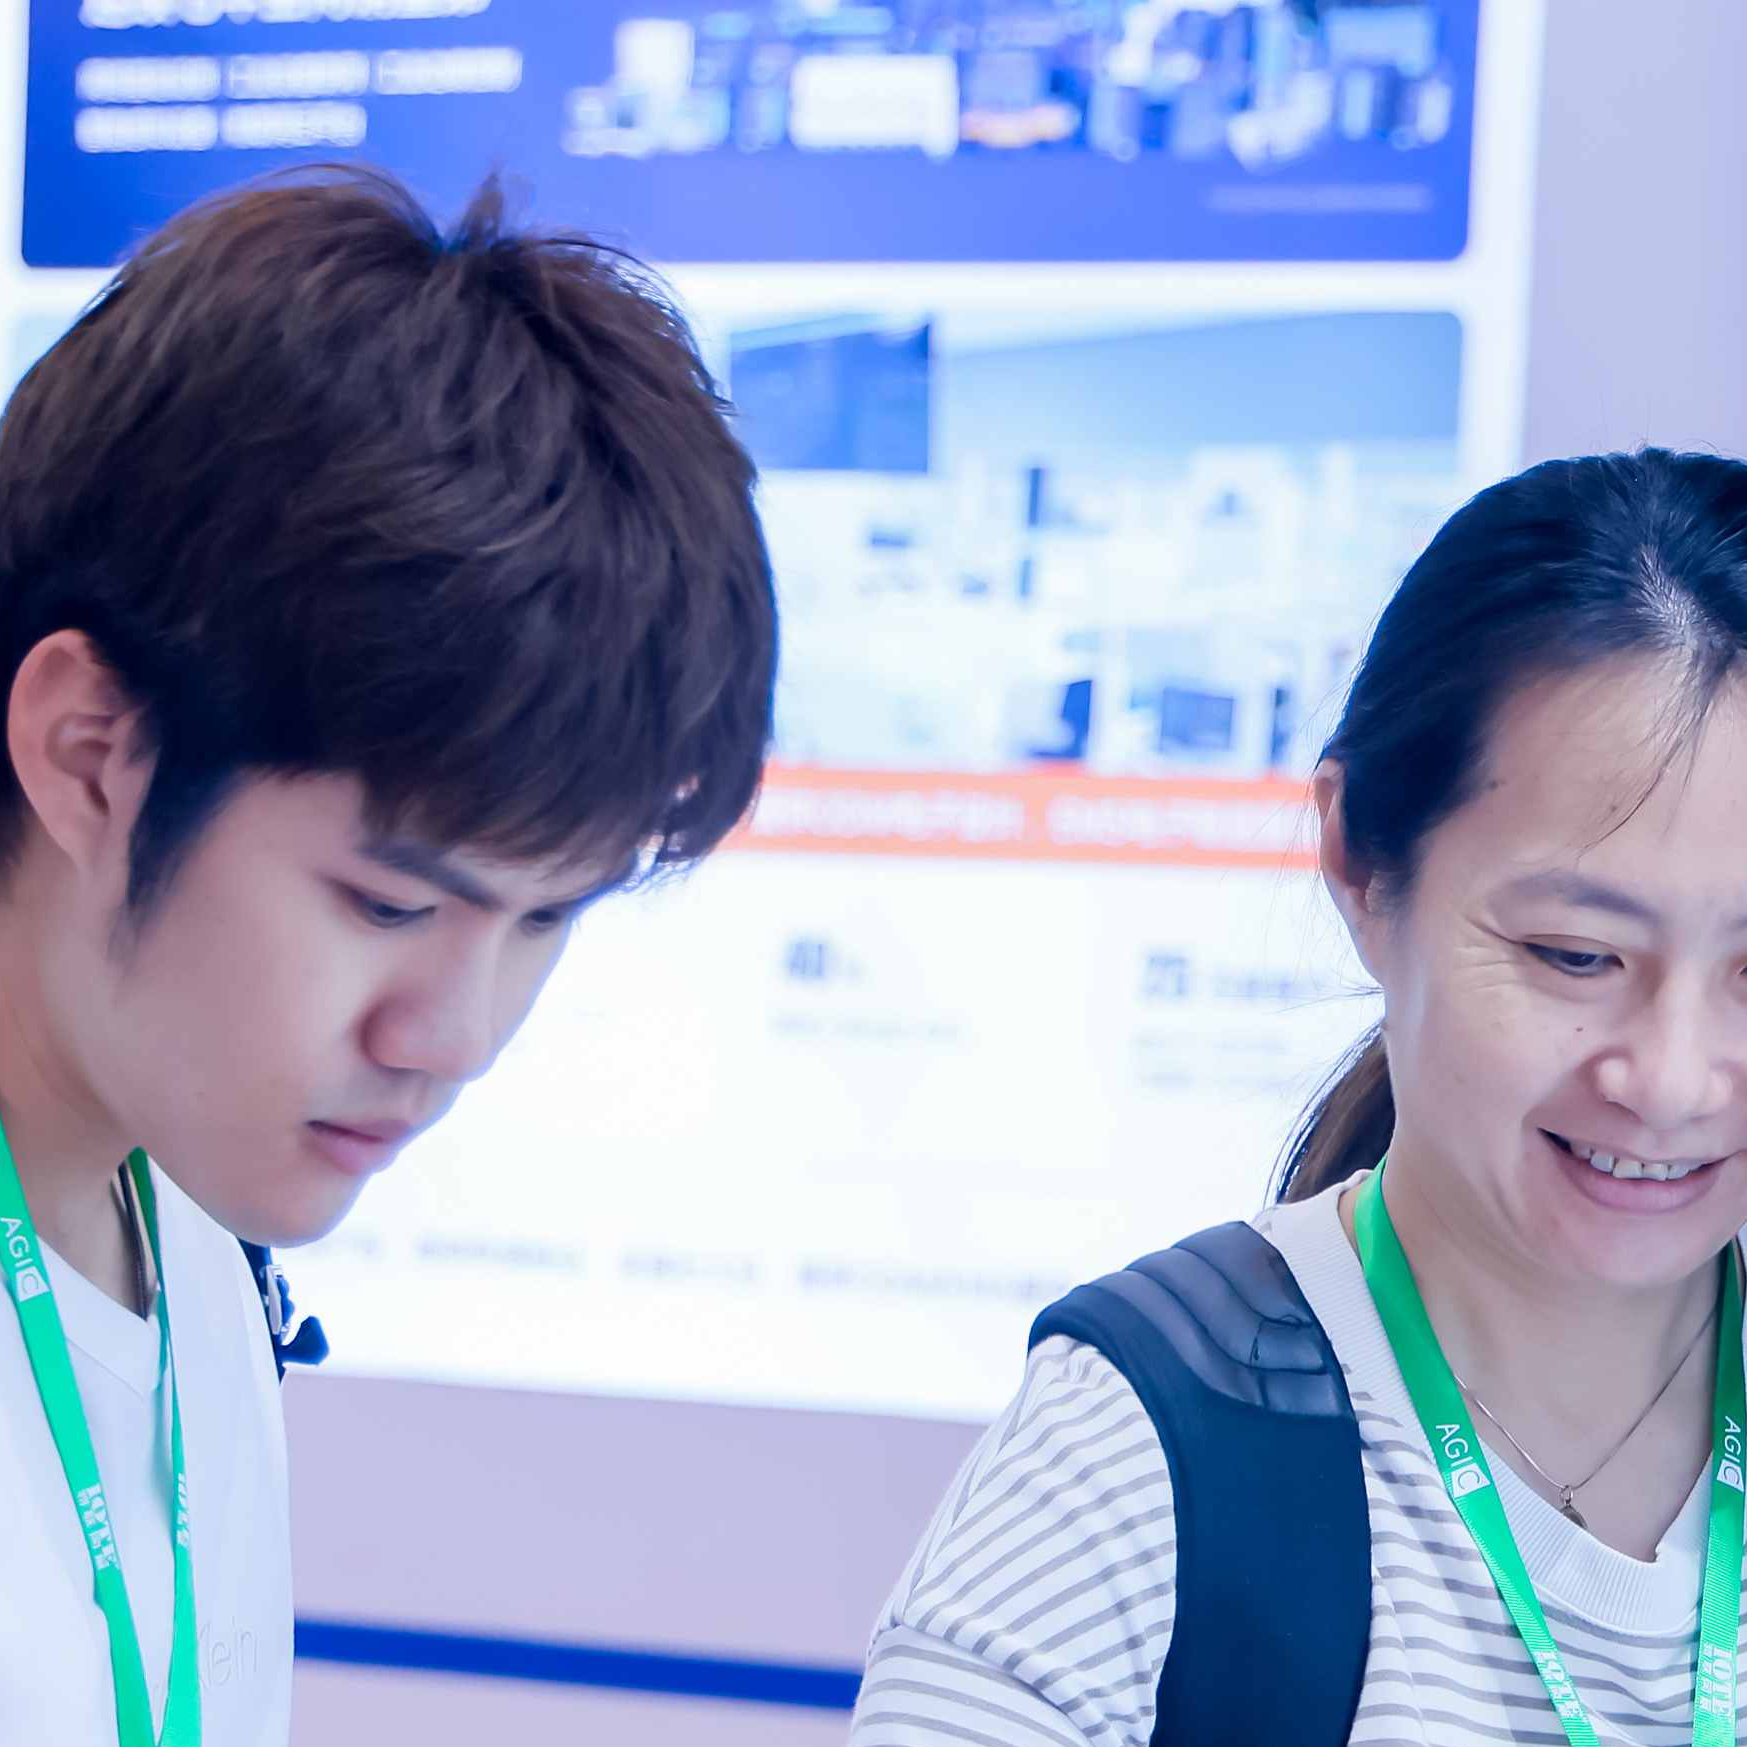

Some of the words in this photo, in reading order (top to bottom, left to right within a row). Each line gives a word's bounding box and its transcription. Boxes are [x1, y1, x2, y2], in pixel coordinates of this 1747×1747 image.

[0, 1217, 50, 1302] AGIC
[1436, 1424, 1490, 1498] AGIC
[1716, 1416, 1744, 1492] AGIC
